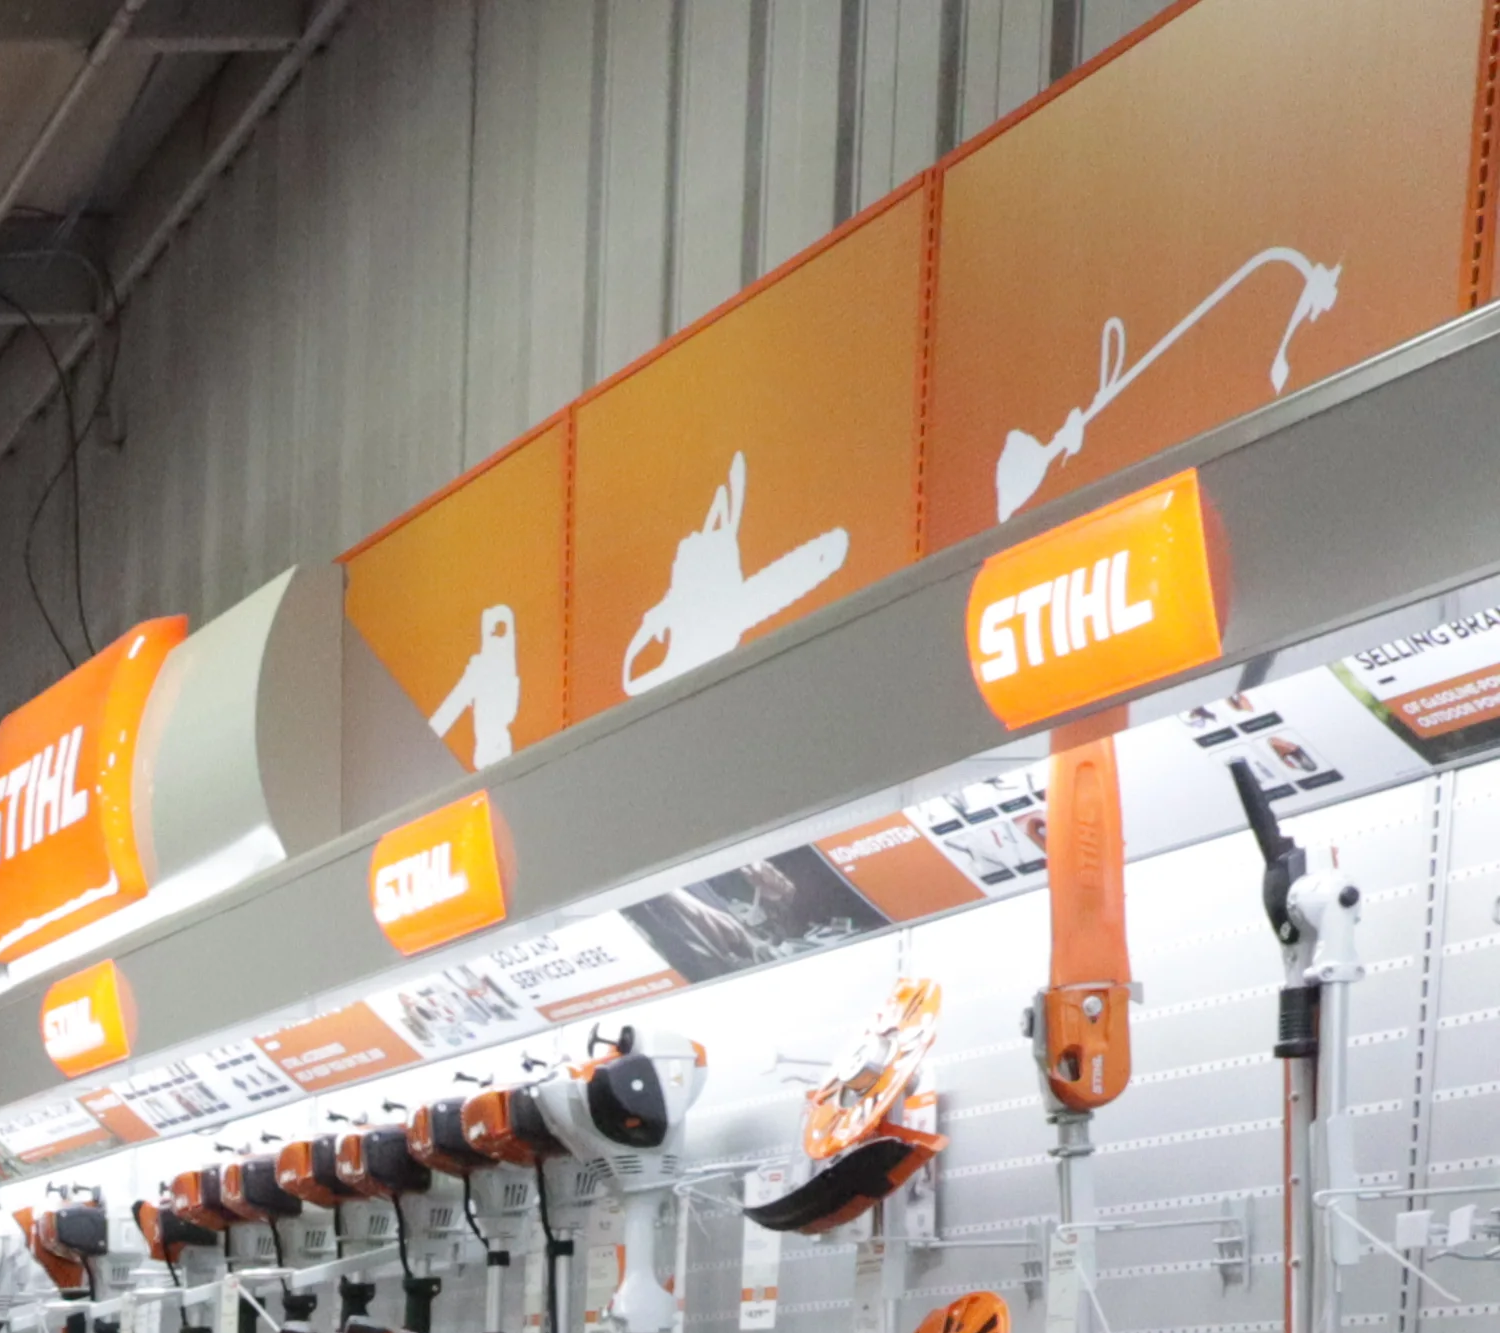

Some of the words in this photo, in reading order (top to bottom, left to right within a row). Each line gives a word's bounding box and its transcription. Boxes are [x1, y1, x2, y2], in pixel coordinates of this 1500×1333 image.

[979, 550, 1153, 682] STIHL
[1355, 622, 1451, 671] SELLING
[1448, 604, 1500, 639] BRA
[1402, 700, 1421, 714] OF
[1420, 674, 1500, 709] GASOLINE-PO
[374, 842, 468, 923] STIHL
[489, 942, 525, 970] SOLD
[508, 957, 577, 991] SERVICED
[45, 997, 104, 1056] STIHL
